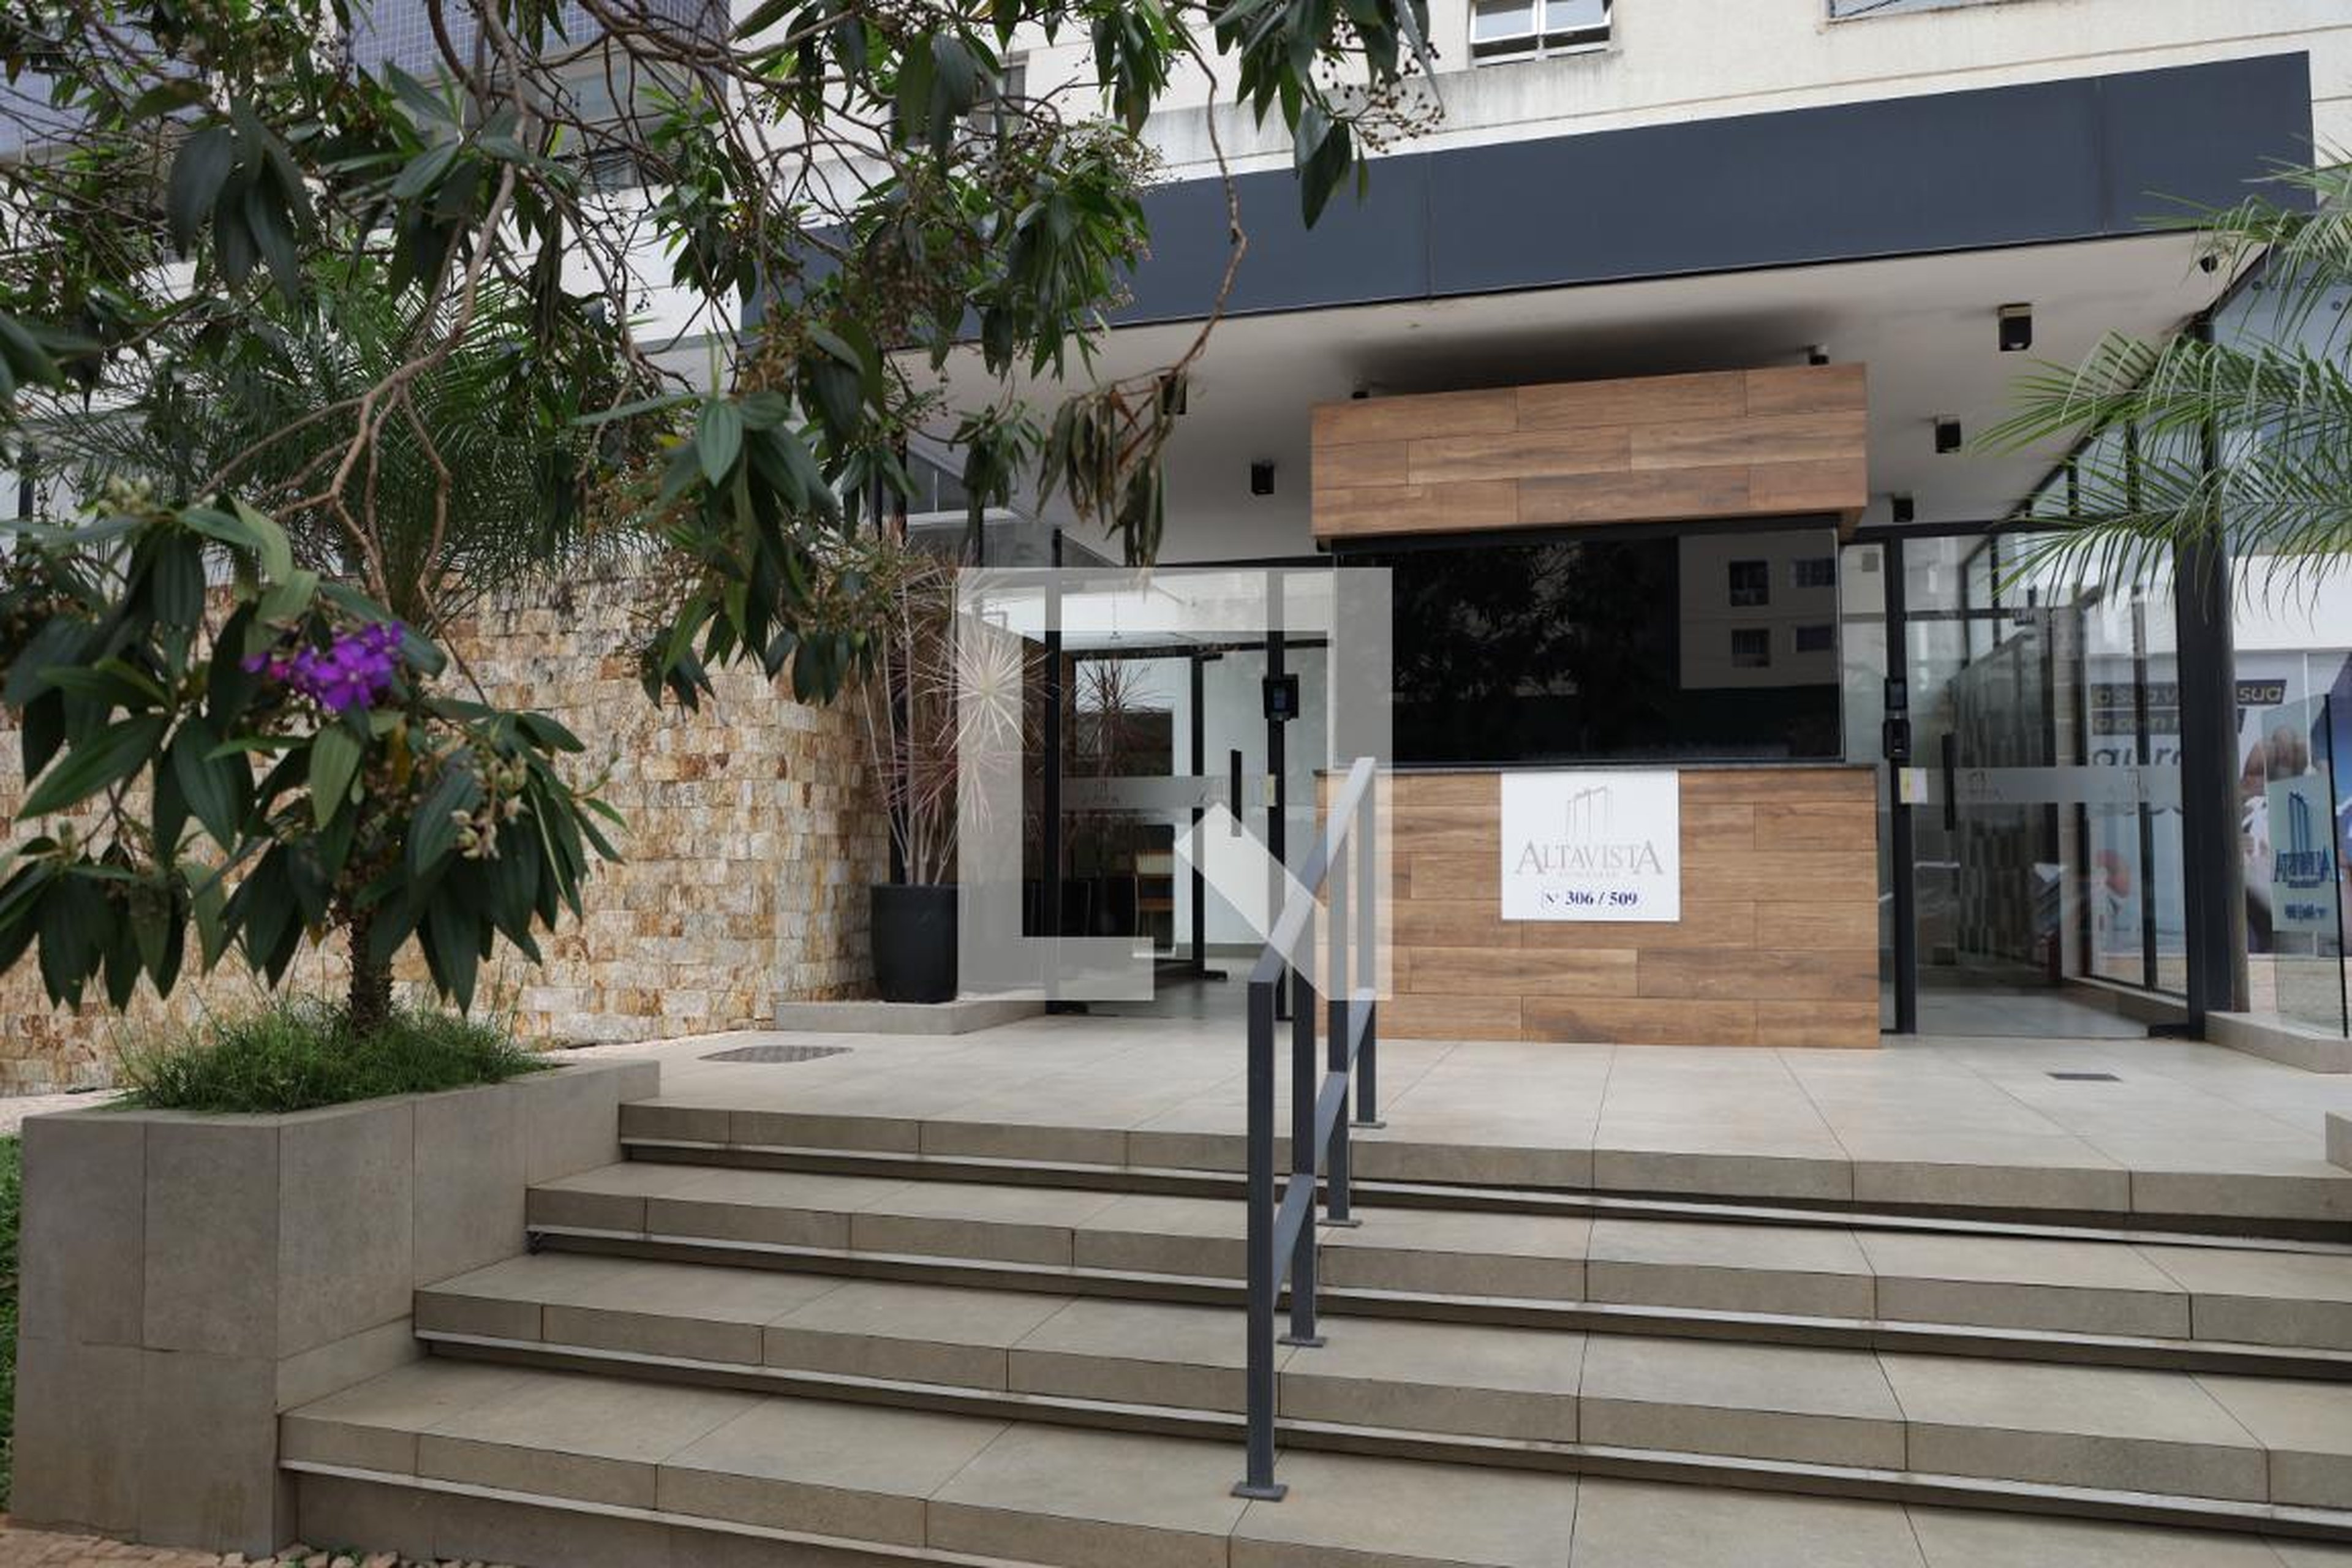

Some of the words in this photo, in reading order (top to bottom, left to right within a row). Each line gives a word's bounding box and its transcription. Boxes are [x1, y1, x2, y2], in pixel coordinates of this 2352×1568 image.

[1515, 840, 1664, 875] ALTAVISTA
[1565, 891, 1594, 905] 306
[1608, 891, 1638, 906] 509
